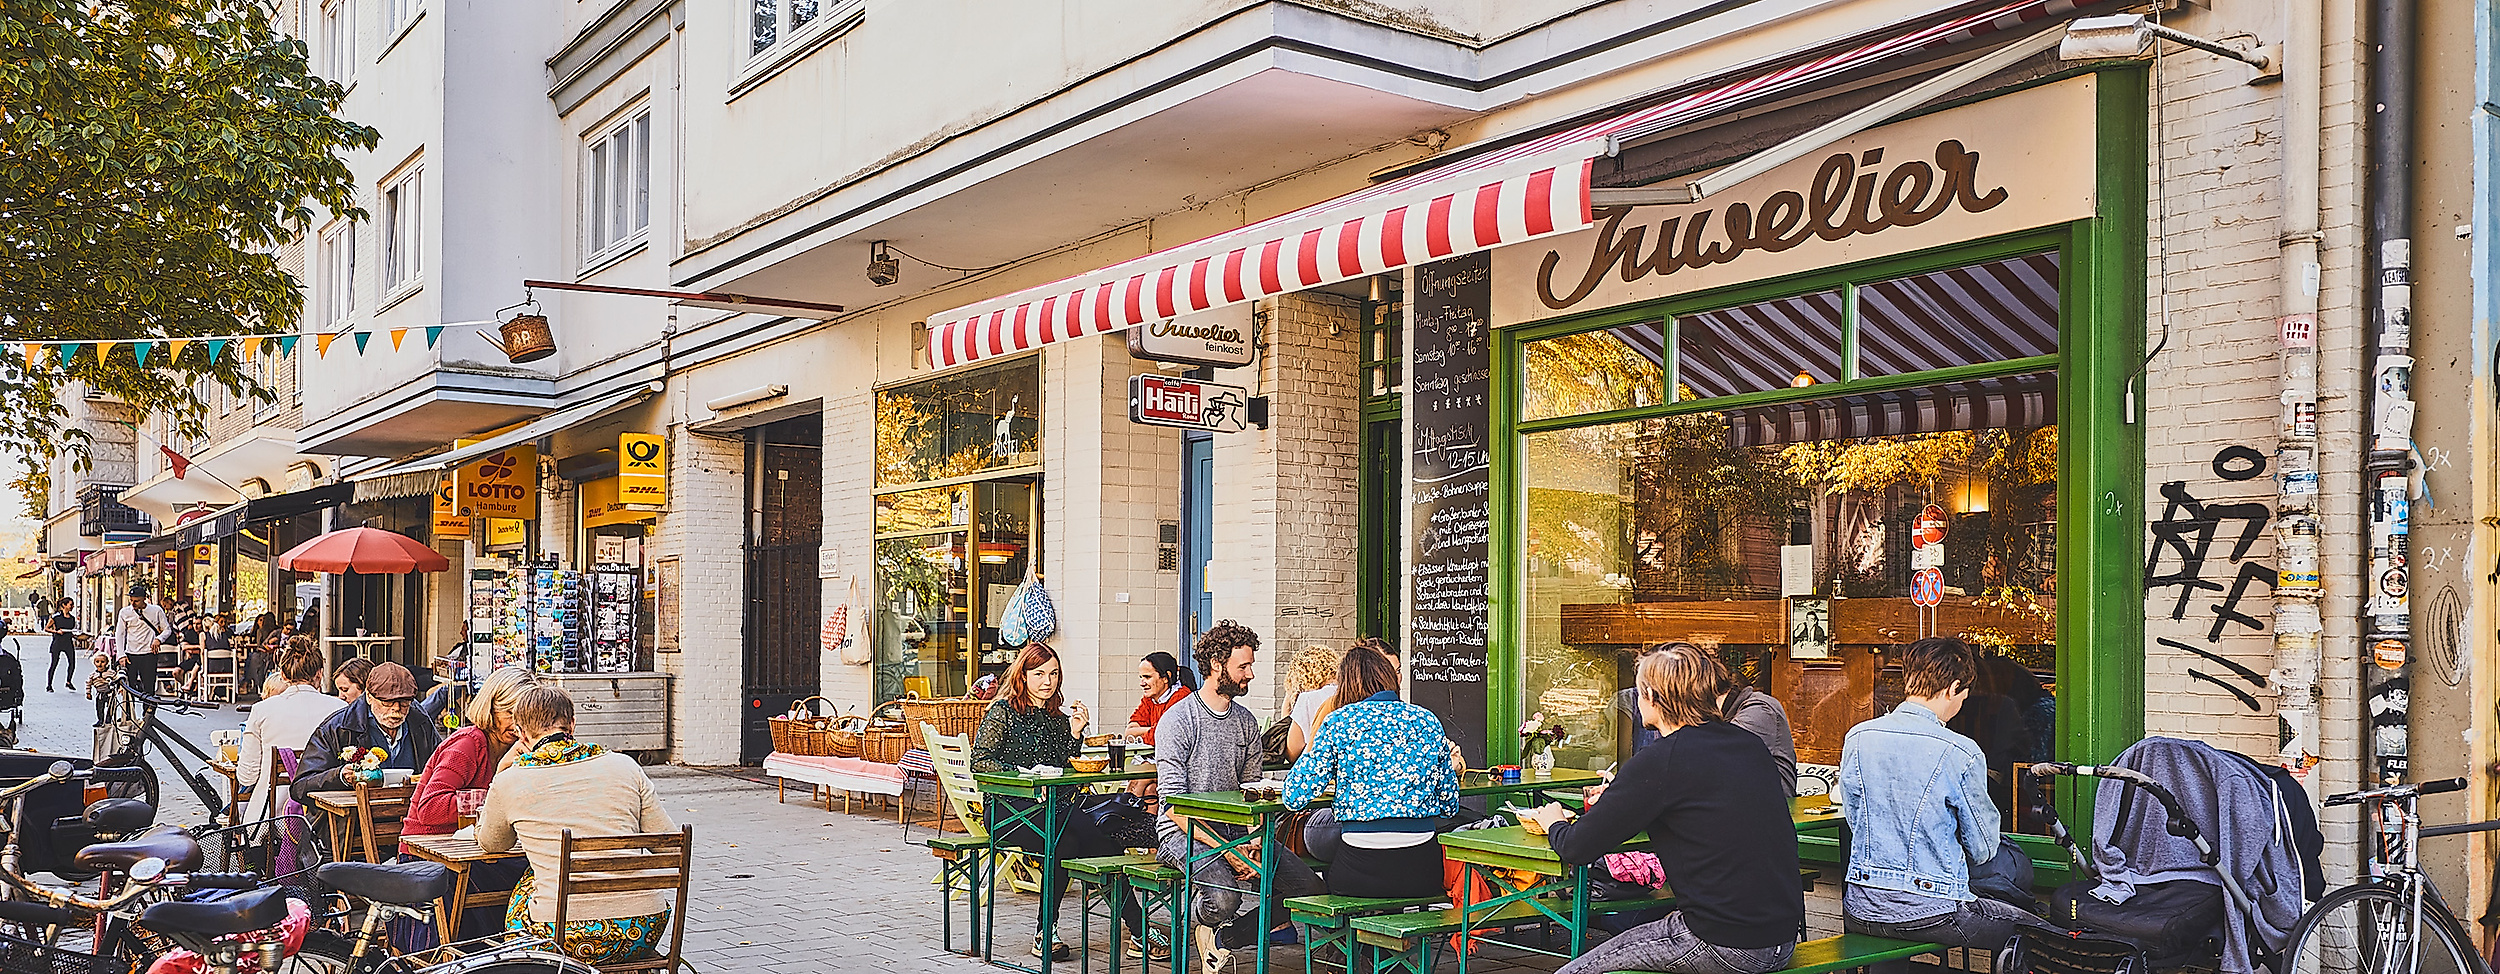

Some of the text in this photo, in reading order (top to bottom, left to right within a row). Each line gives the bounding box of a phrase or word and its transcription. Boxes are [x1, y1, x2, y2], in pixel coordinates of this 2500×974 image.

[1536, 138, 2009, 311] Juwelier
[1150, 319, 1245, 344] Juwelier
[1205, 342, 1244, 356] feinkost
[1414, 343, 1446, 368] Samstag
[1414, 366, 1490, 396] Sonntag geschlosse
[1447, 450, 1476, 470] 12-15
[469, 482, 526, 500] LOTTO
[628, 486, 659, 494] DHL
[477, 501, 517, 514] Hamburg
[2421, 546, 2453, 572] 2x
[596, 564, 630, 572] GOLDBEK
[1469, 583, 1483, 597] und
[1416, 651, 1440, 668] Pasta
[1440, 656, 1449, 667] in
[1434, 668, 1448, 682] mit
